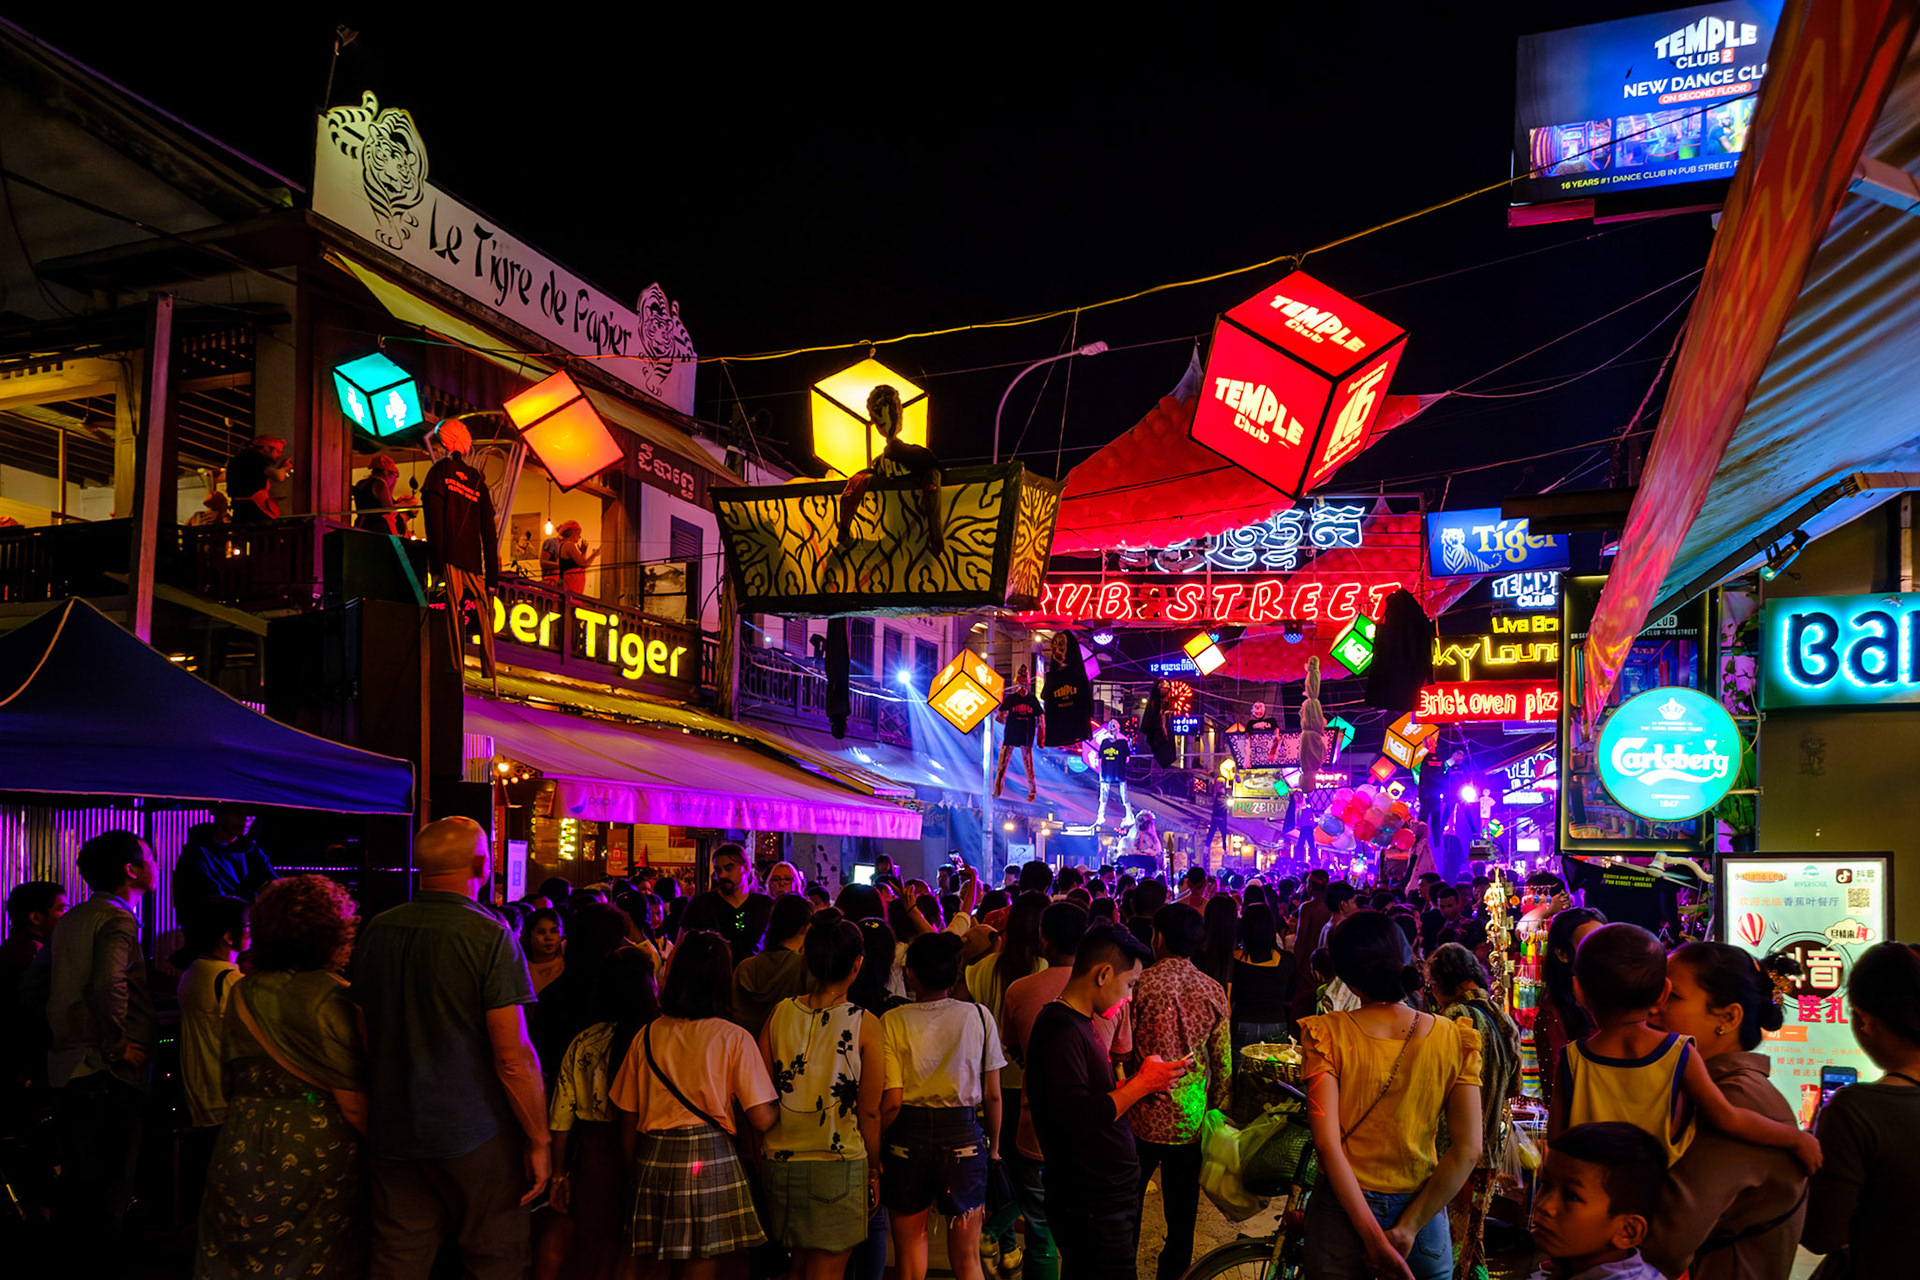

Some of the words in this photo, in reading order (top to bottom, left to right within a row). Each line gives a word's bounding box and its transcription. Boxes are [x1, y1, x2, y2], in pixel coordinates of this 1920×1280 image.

[1654, 16, 1758, 60] TEMPLE
[1676, 51, 1720, 69] CLUB
[1623, 78, 1668, 99] NEW
[1671, 68, 1735, 92] DANCE
[1662, 94, 1677, 104] ON
[1678, 88, 1716, 101] SECOND
[1716, 83, 1748, 97] FLOOR
[1571, 178, 1600, 188] YEARS
[1600, 176, 1611, 185] #1
[1612, 172, 1642, 184] DANCE
[1643, 169, 1666, 180] CLUB
[1667, 168, 1677, 176] IN
[1678, 165, 1697, 175] PUB
[429, 198, 463, 265] Le
[473, 222, 533, 307] Tigre
[541, 269, 567, 326] de
[573, 288, 632, 361] Papier
[1270, 295, 1366, 352] TEMPLE
[1285, 318, 1324, 344] Club
[1215, 377, 1304, 446] TEMPLE
[1234, 413, 1270, 444] Club
[1471, 518, 1558, 563] Tiger
[1166, 580, 1401, 621] STREET
[1492, 571, 1559, 598] TEMPL
[1517, 594, 1556, 607] CLUB
[1492, 617, 1528, 634] Live
[575, 607, 688, 680] Tiger
[1787, 609, 1920, 688] Ba
[1416, 688, 1469, 717] Brick
[1469, 692, 1516, 715] oven
[1525, 688, 1559, 722] pizz
[1611, 737, 1729, 779] Carlsberg
[1234, 801, 1286, 814] PIZZERIA
